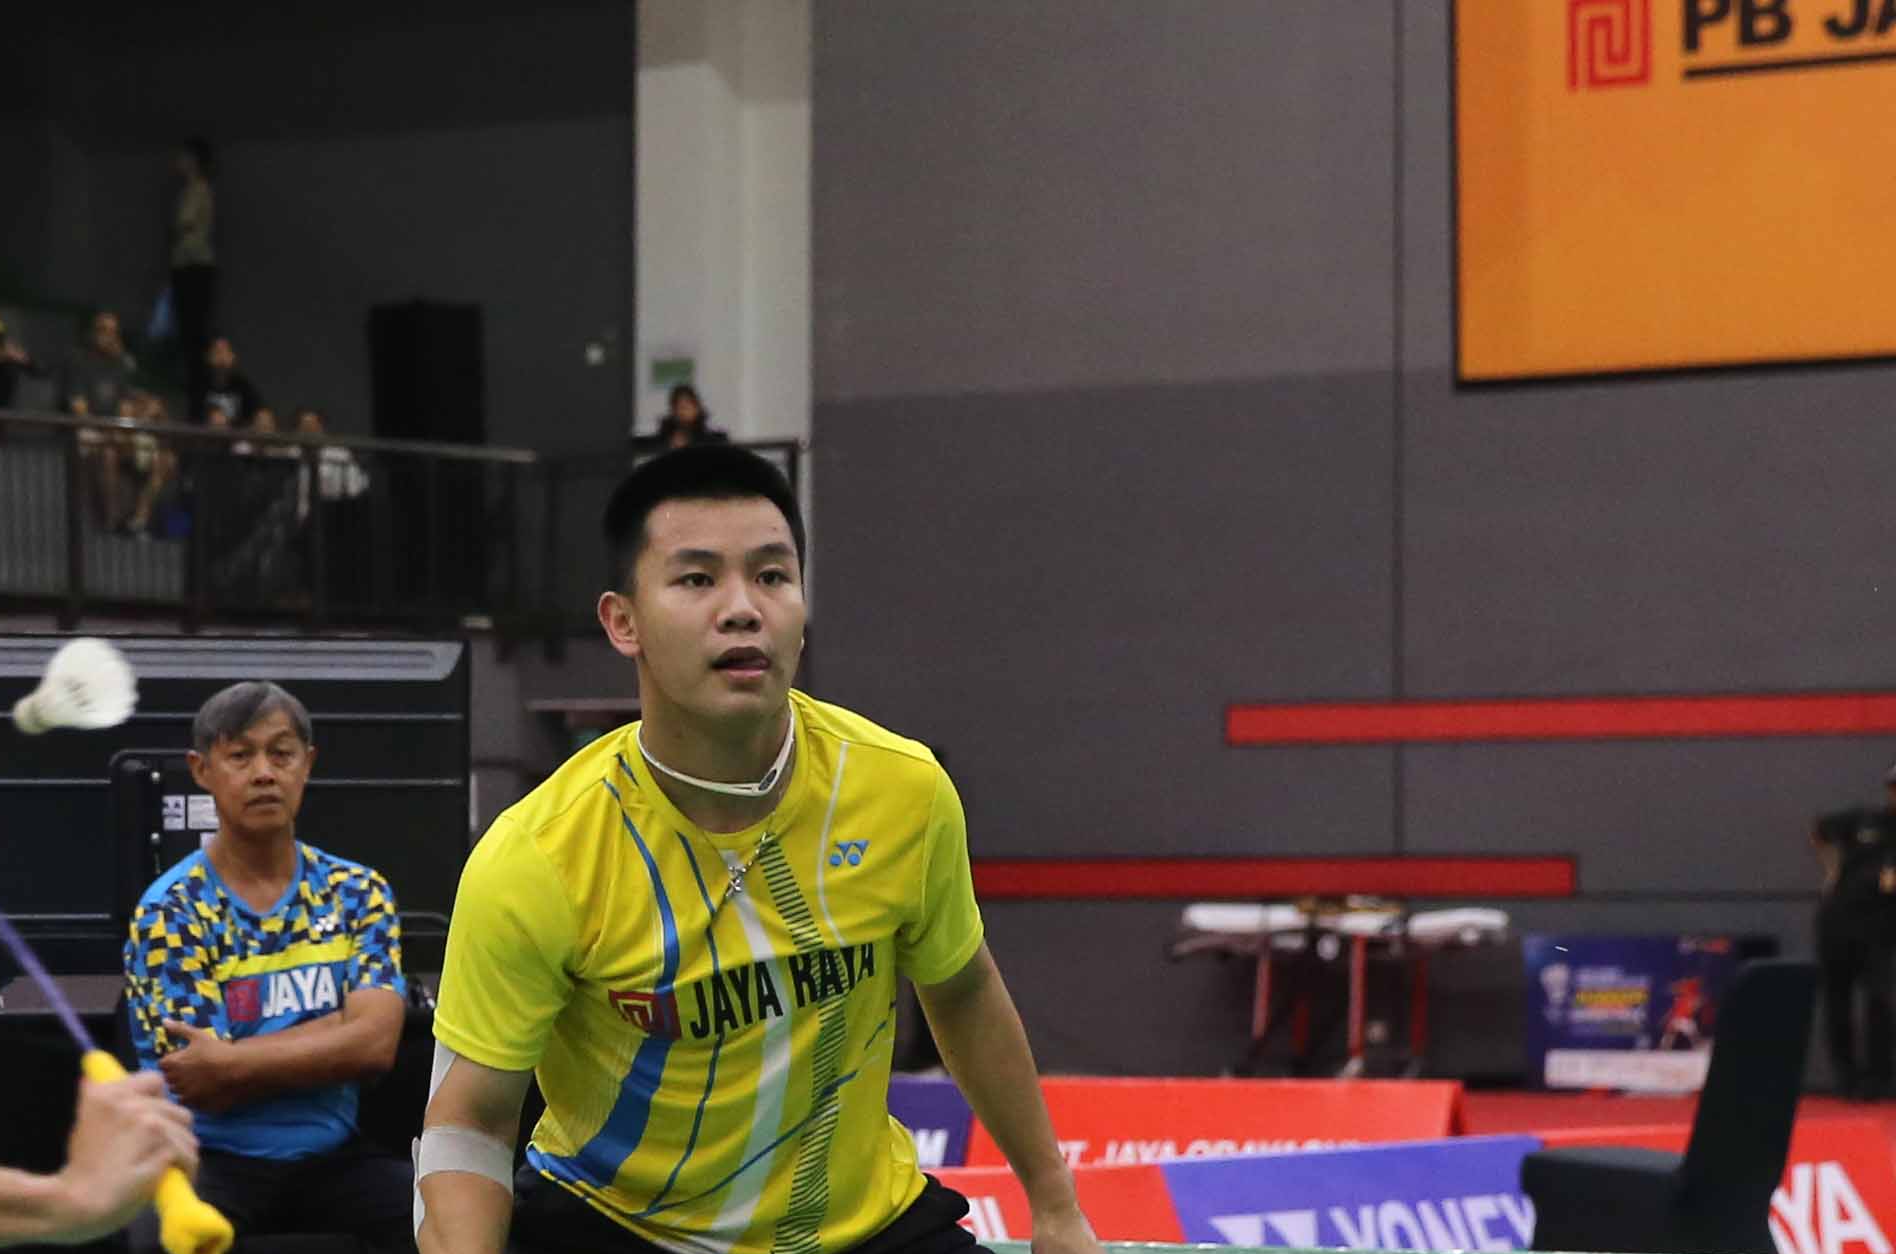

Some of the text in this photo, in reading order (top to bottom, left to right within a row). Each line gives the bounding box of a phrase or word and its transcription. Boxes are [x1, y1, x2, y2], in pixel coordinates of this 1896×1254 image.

[1684, 0, 1792, 52] PB
[261, 964, 339, 1018] JAYA
[688, 942, 875, 1039] JAYA RAYA
